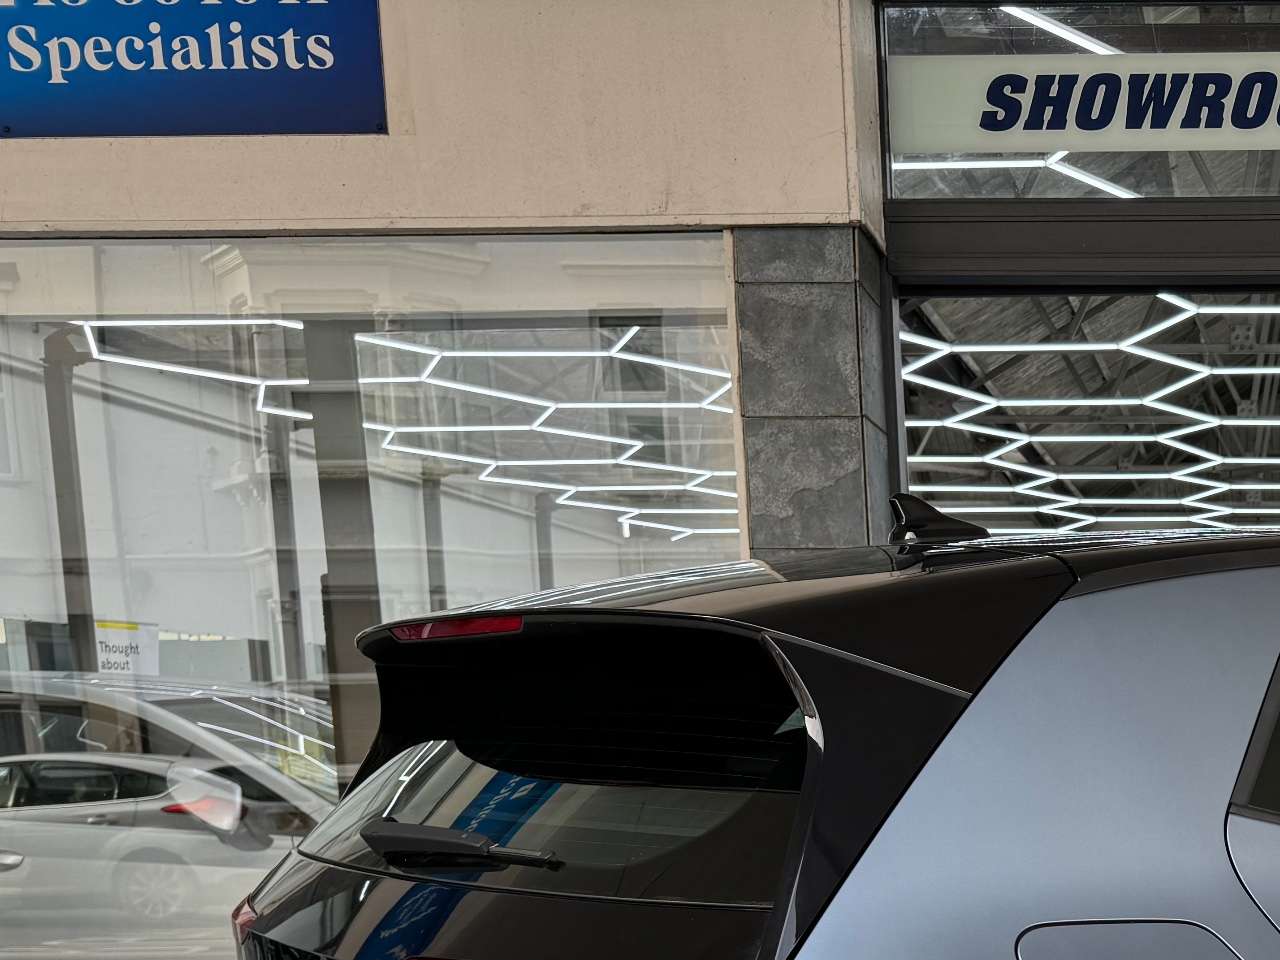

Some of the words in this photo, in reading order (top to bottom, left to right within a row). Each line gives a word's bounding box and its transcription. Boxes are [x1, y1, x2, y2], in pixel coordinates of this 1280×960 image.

[7, 21, 335, 84] Specialists
[98, 641, 140, 657] Thought
[101, 658, 130, 671] about
